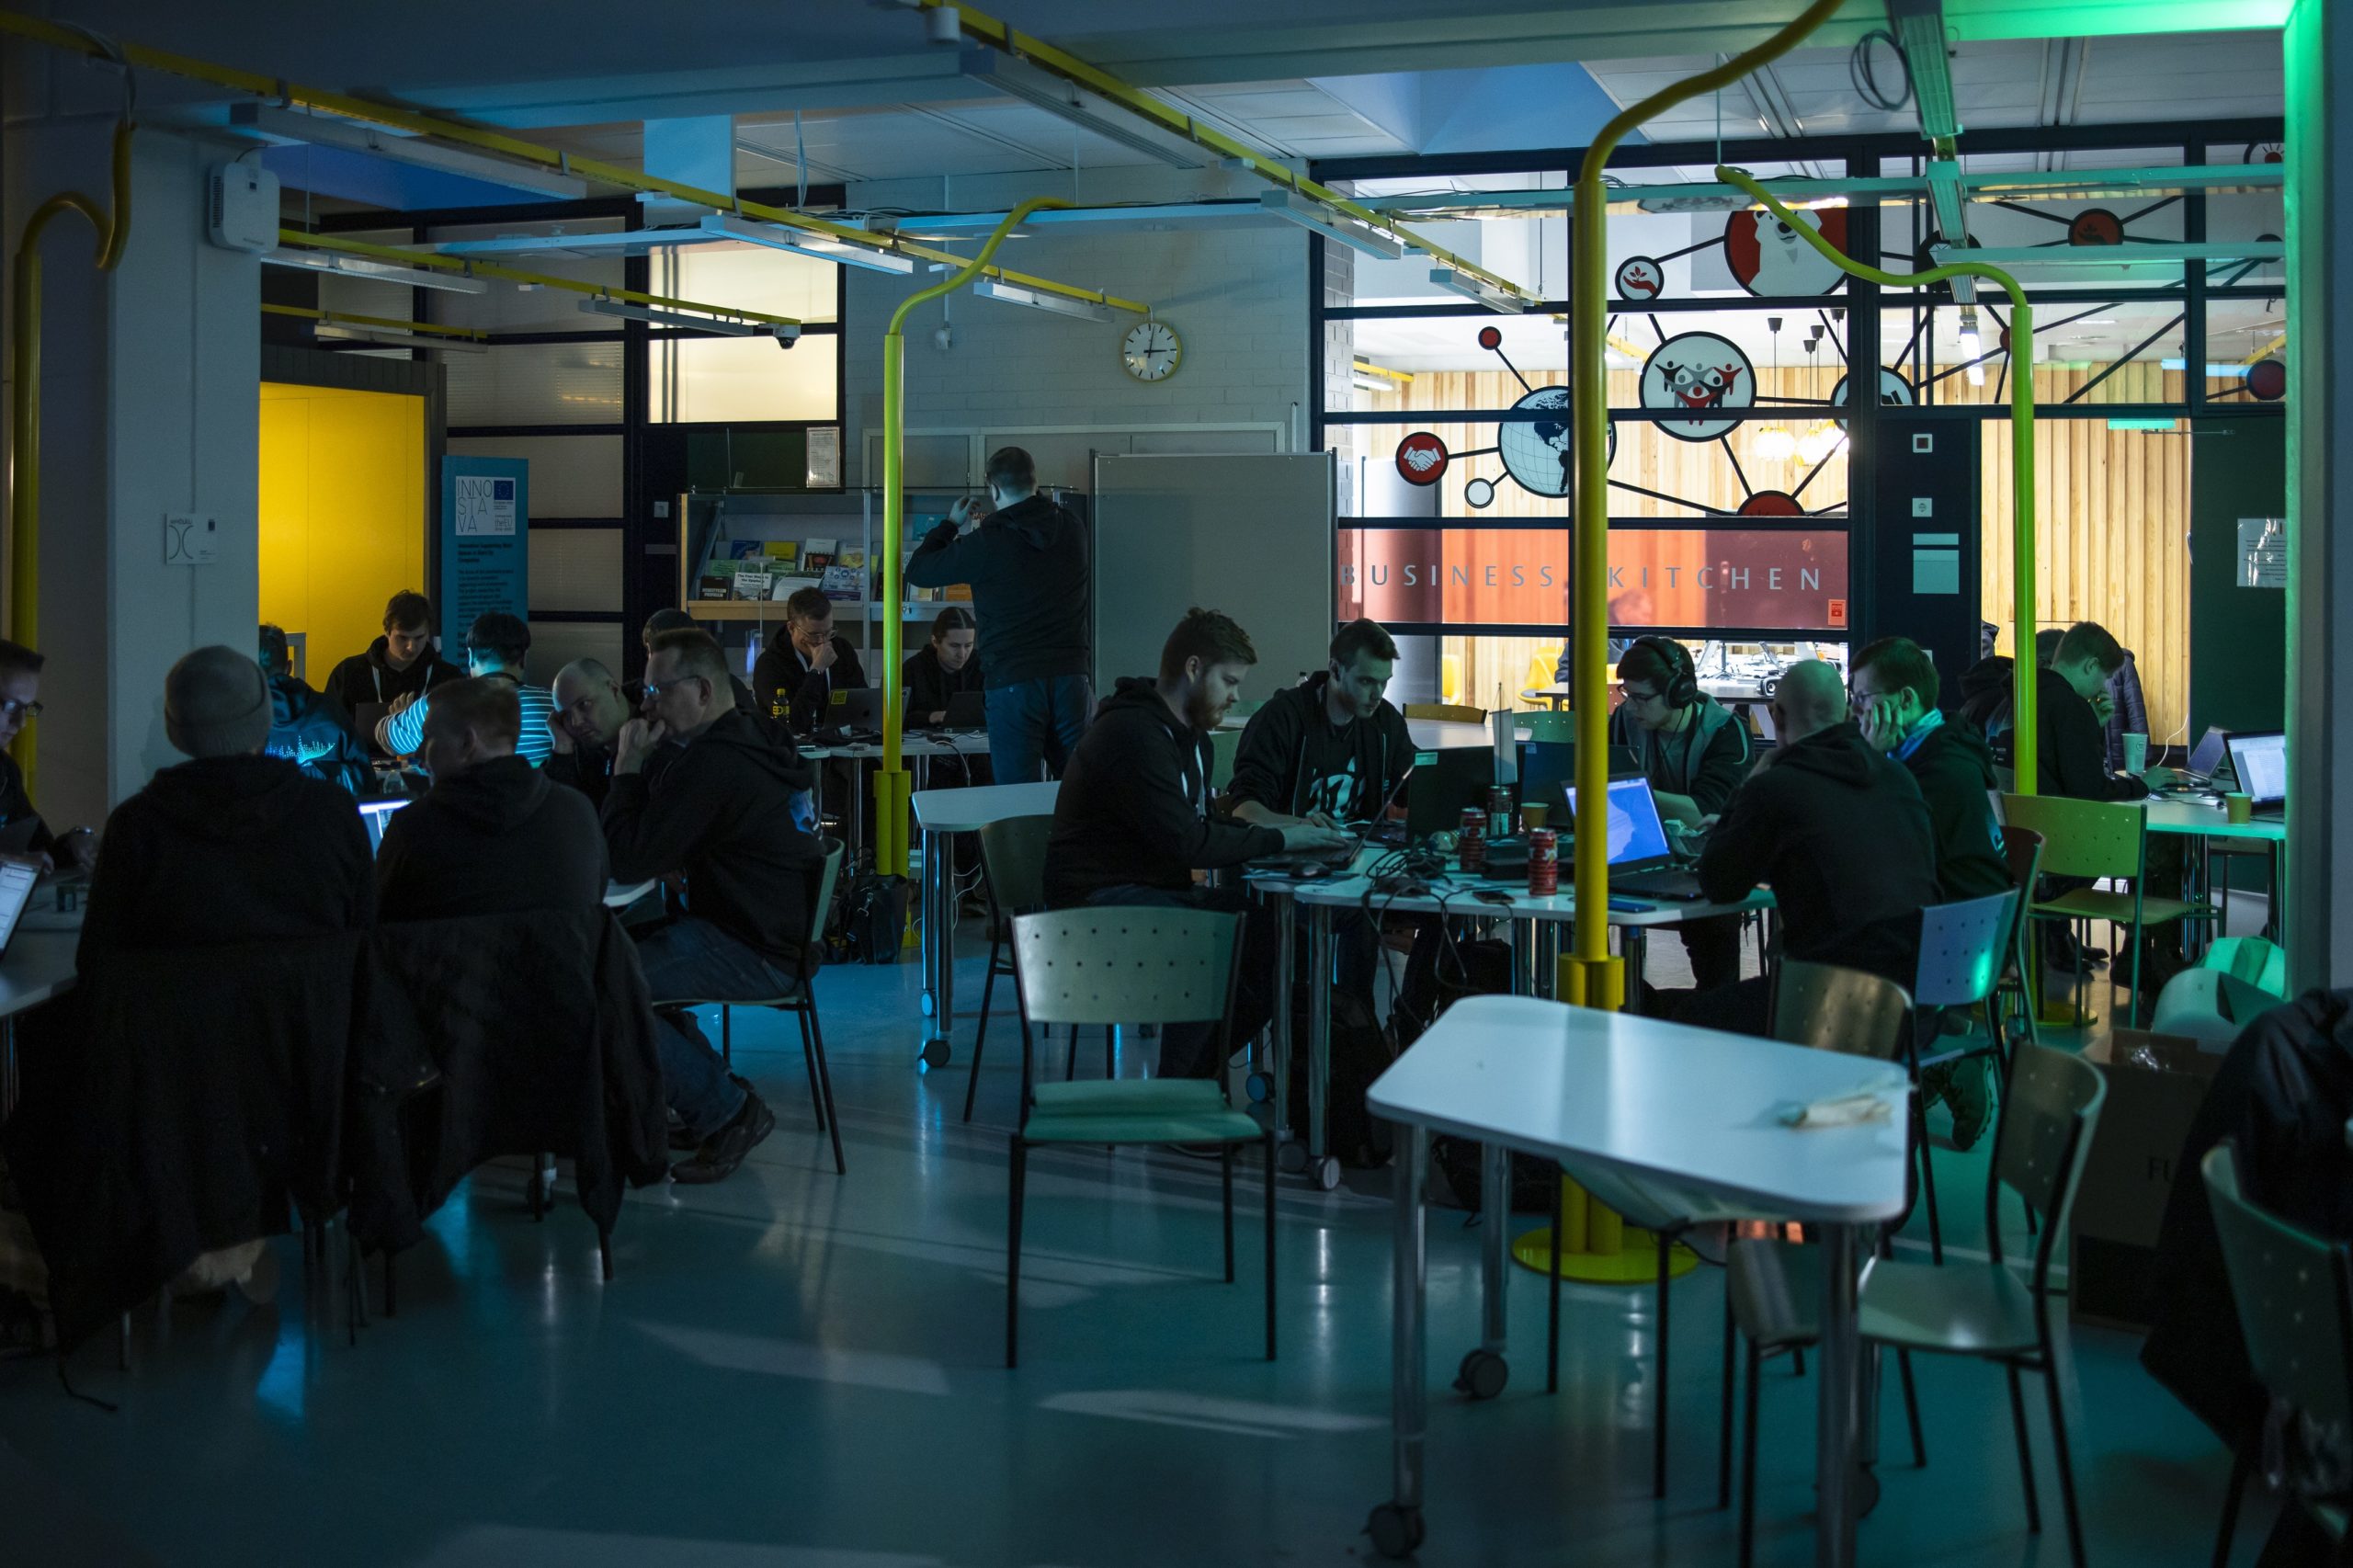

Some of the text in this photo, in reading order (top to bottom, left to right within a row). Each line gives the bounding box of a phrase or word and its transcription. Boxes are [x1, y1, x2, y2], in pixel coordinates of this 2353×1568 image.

[457, 479, 493, 497] INNO
[458, 496, 487, 515] STA
[458, 515, 477, 532] VA
[1340, 564, 1820, 590] BUSINESS KITCHEN
